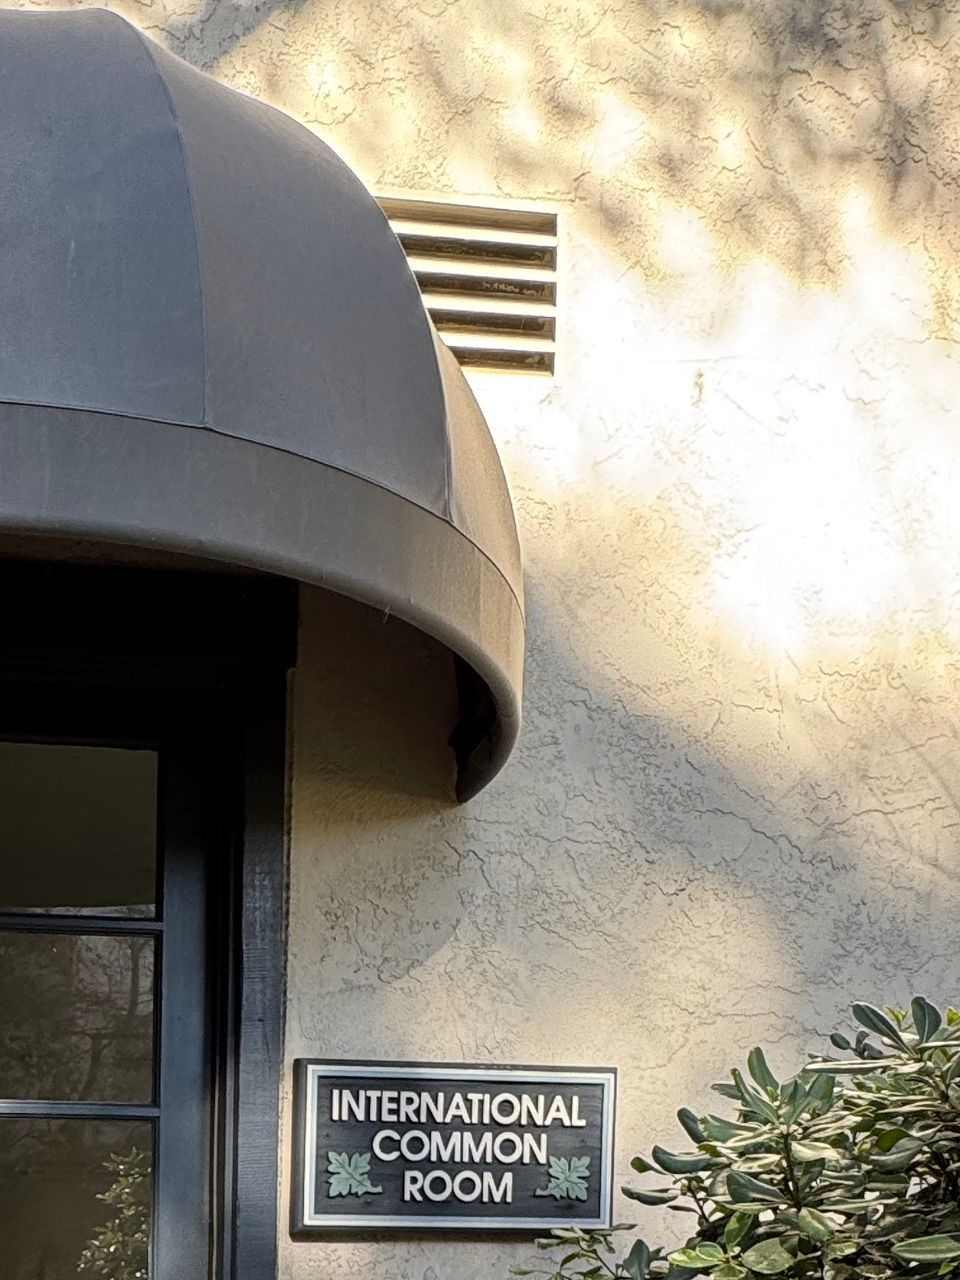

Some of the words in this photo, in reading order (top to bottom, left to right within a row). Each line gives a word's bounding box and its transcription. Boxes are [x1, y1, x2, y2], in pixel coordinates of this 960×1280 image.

[331, 1089, 587, 1127] INTERNATIONAL
[372, 1129, 548, 1164] COMMON
[404, 1170, 513, 1203] ROOM
